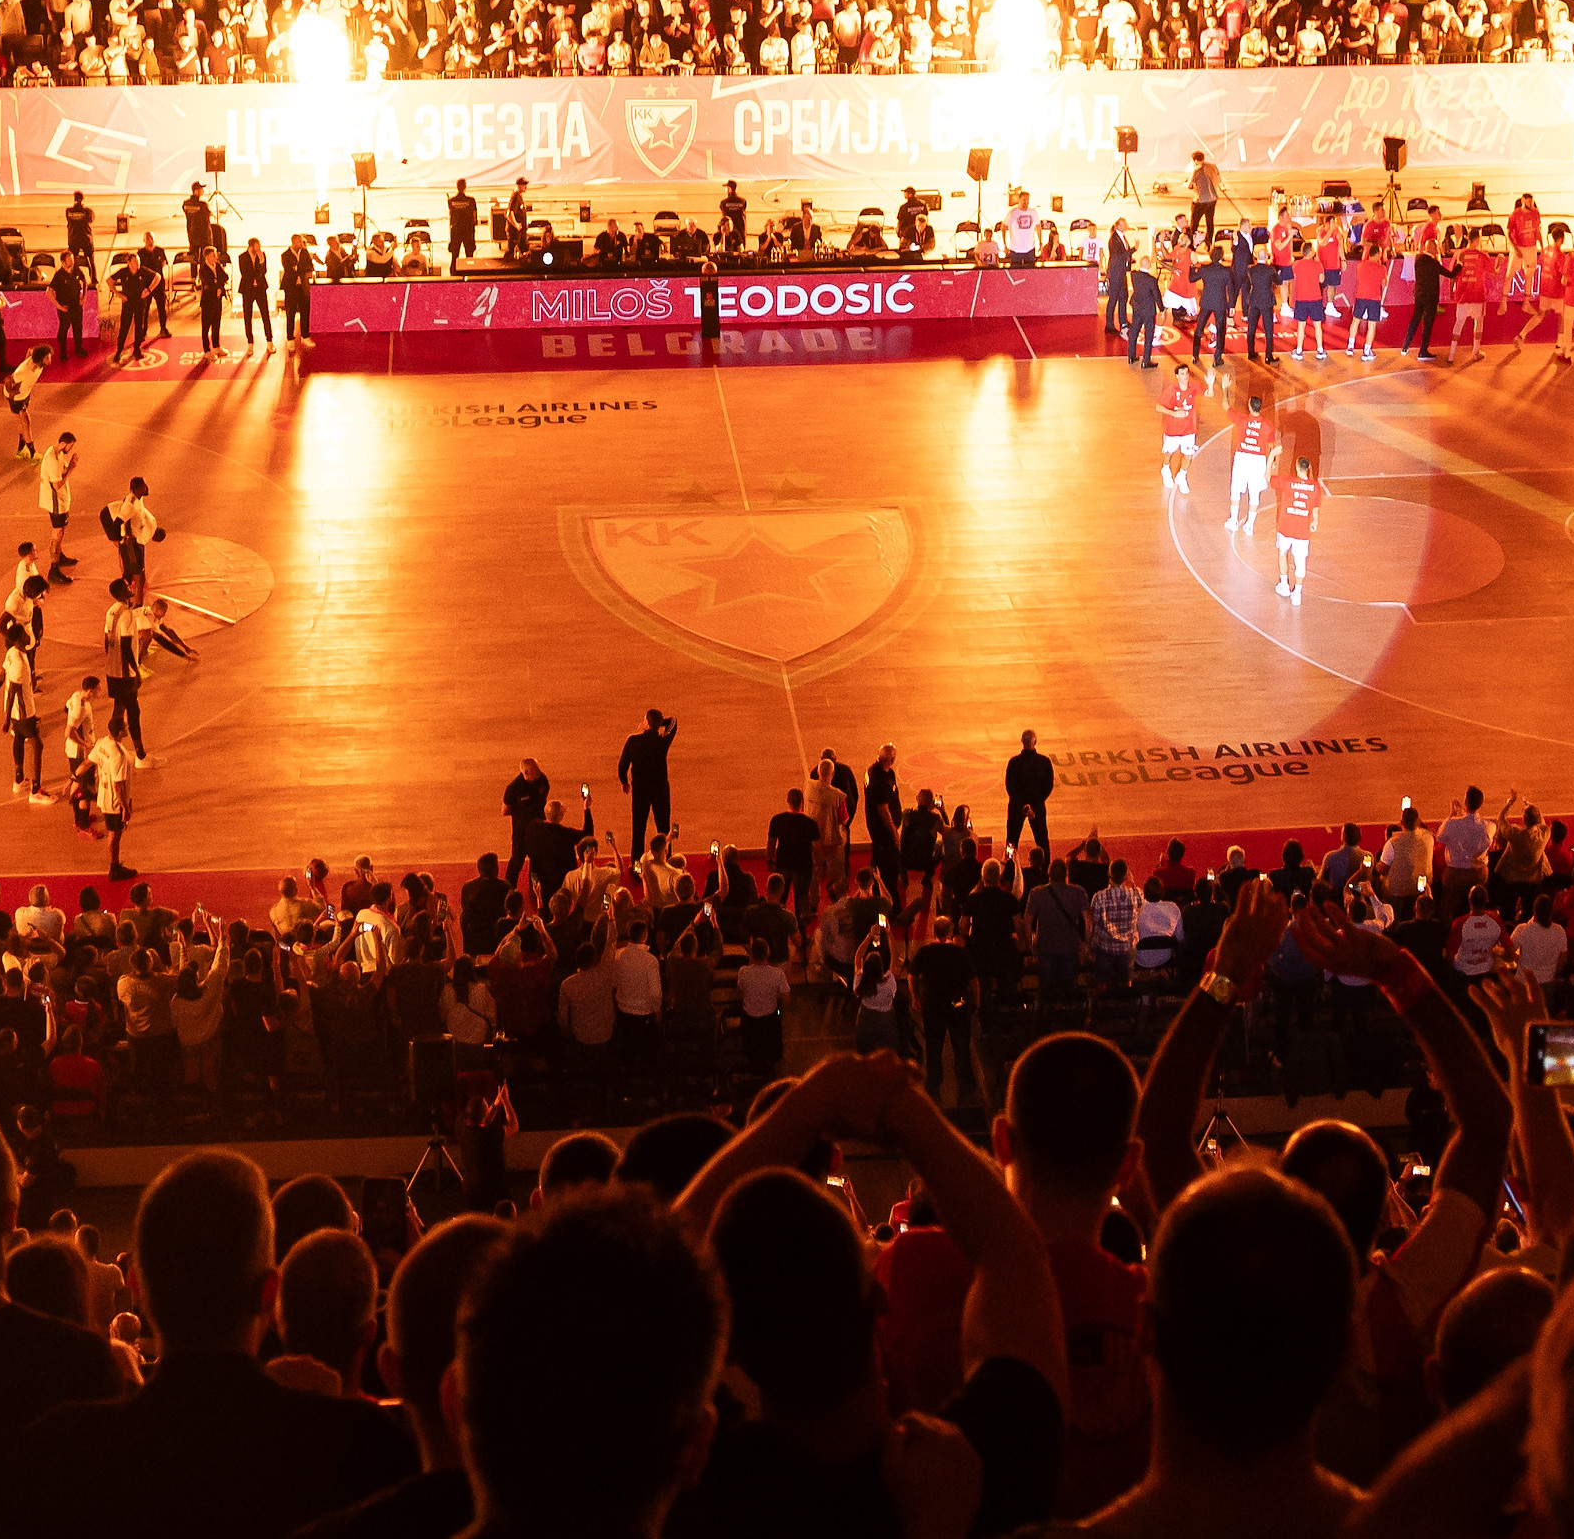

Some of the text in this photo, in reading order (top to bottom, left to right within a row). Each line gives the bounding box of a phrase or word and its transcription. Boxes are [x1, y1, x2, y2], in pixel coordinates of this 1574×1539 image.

[633, 108, 653, 120] KK
[226, 100, 592, 177] ЦРНА ЗВЕЗДА
[733, 99, 920, 166] СРБИЈА,
[532, 280, 673, 323] MILOŠ
[685, 274, 916, 318] TEODOSIĆ
[541, 326, 878, 359] BELGRADE
[515, 399, 658, 412] AIRLINES
[604, 520, 710, 547] KK
[1050, 736, 1390, 769] URKISH AIRLINES
[1055, 758, 1313, 787] uroLeague
